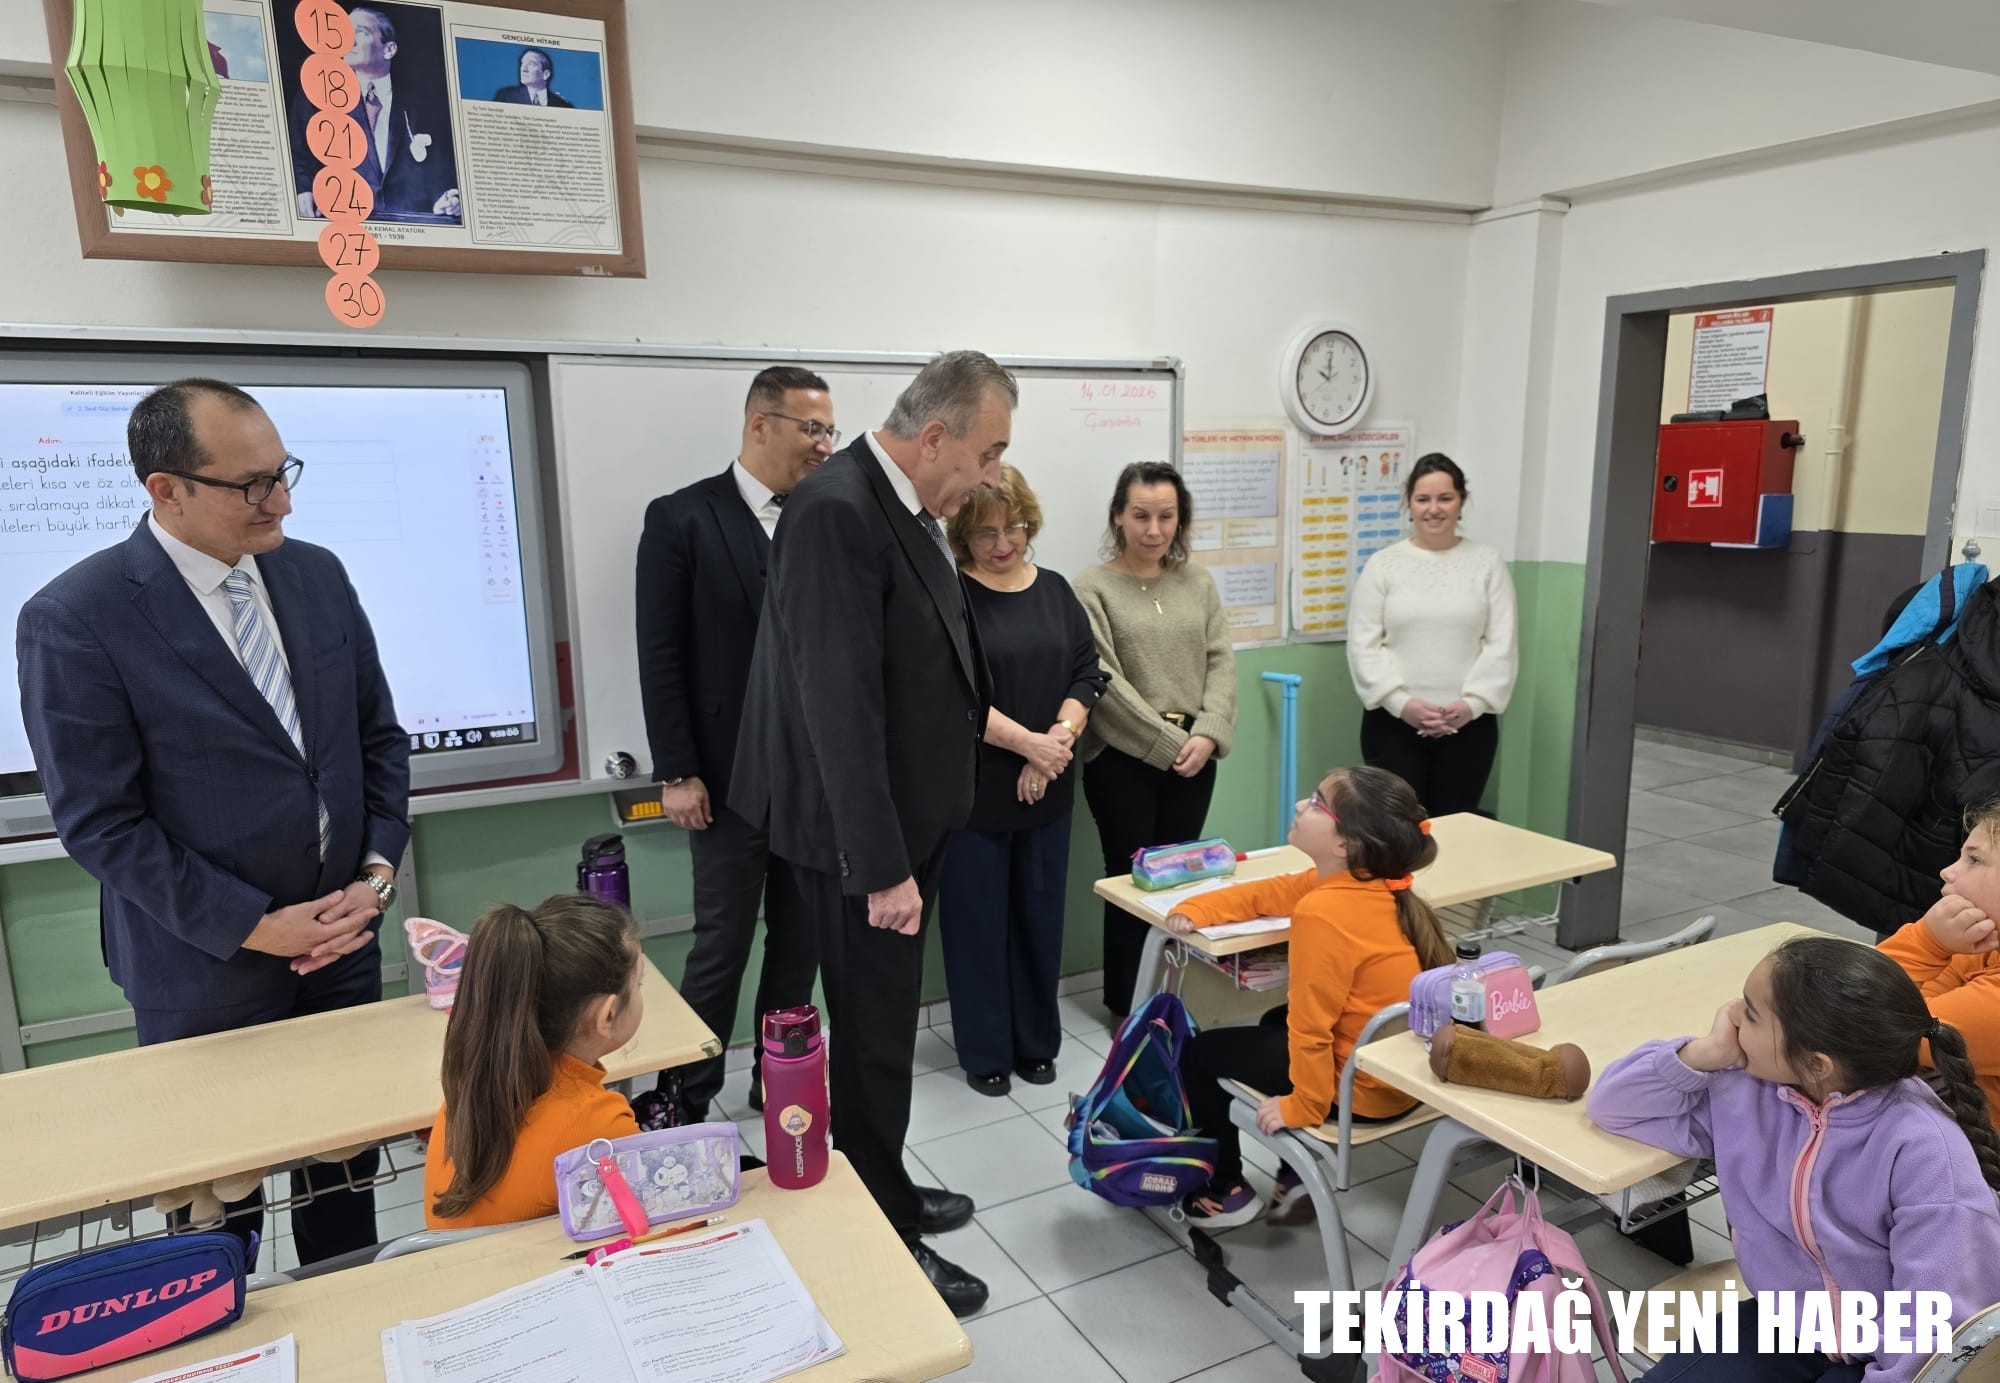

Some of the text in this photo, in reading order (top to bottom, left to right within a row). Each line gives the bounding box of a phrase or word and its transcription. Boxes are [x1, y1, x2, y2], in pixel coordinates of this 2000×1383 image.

[309, 8, 343, 50] 15
[501, 33, 561, 47] GENÇLİĞE HİTABE
[317, 68, 349, 108] 18
[318, 119, 352, 160] 21
[325, 175, 368, 217] 24
[329, 232, 373, 267] 27
[338, 282, 381, 319] 30
[11, 453, 80, 474] aşağıdaki
[87, 454, 136, 467] ifadele
[0, 475, 34, 490] eleri
[40, 475, 67, 489] kısa
[73, 479, 91, 489] ve
[97, 478, 113, 489] öz
[9, 497, 89, 515] sıralamaya
[96, 496, 135, 510] dikkat
[47, 517, 90, 536] büyük
[96, 515, 139, 532] harfle
[1490, 988, 1531, 1021] Barbie
[36, 1268, 218, 1337] DUNLOP
